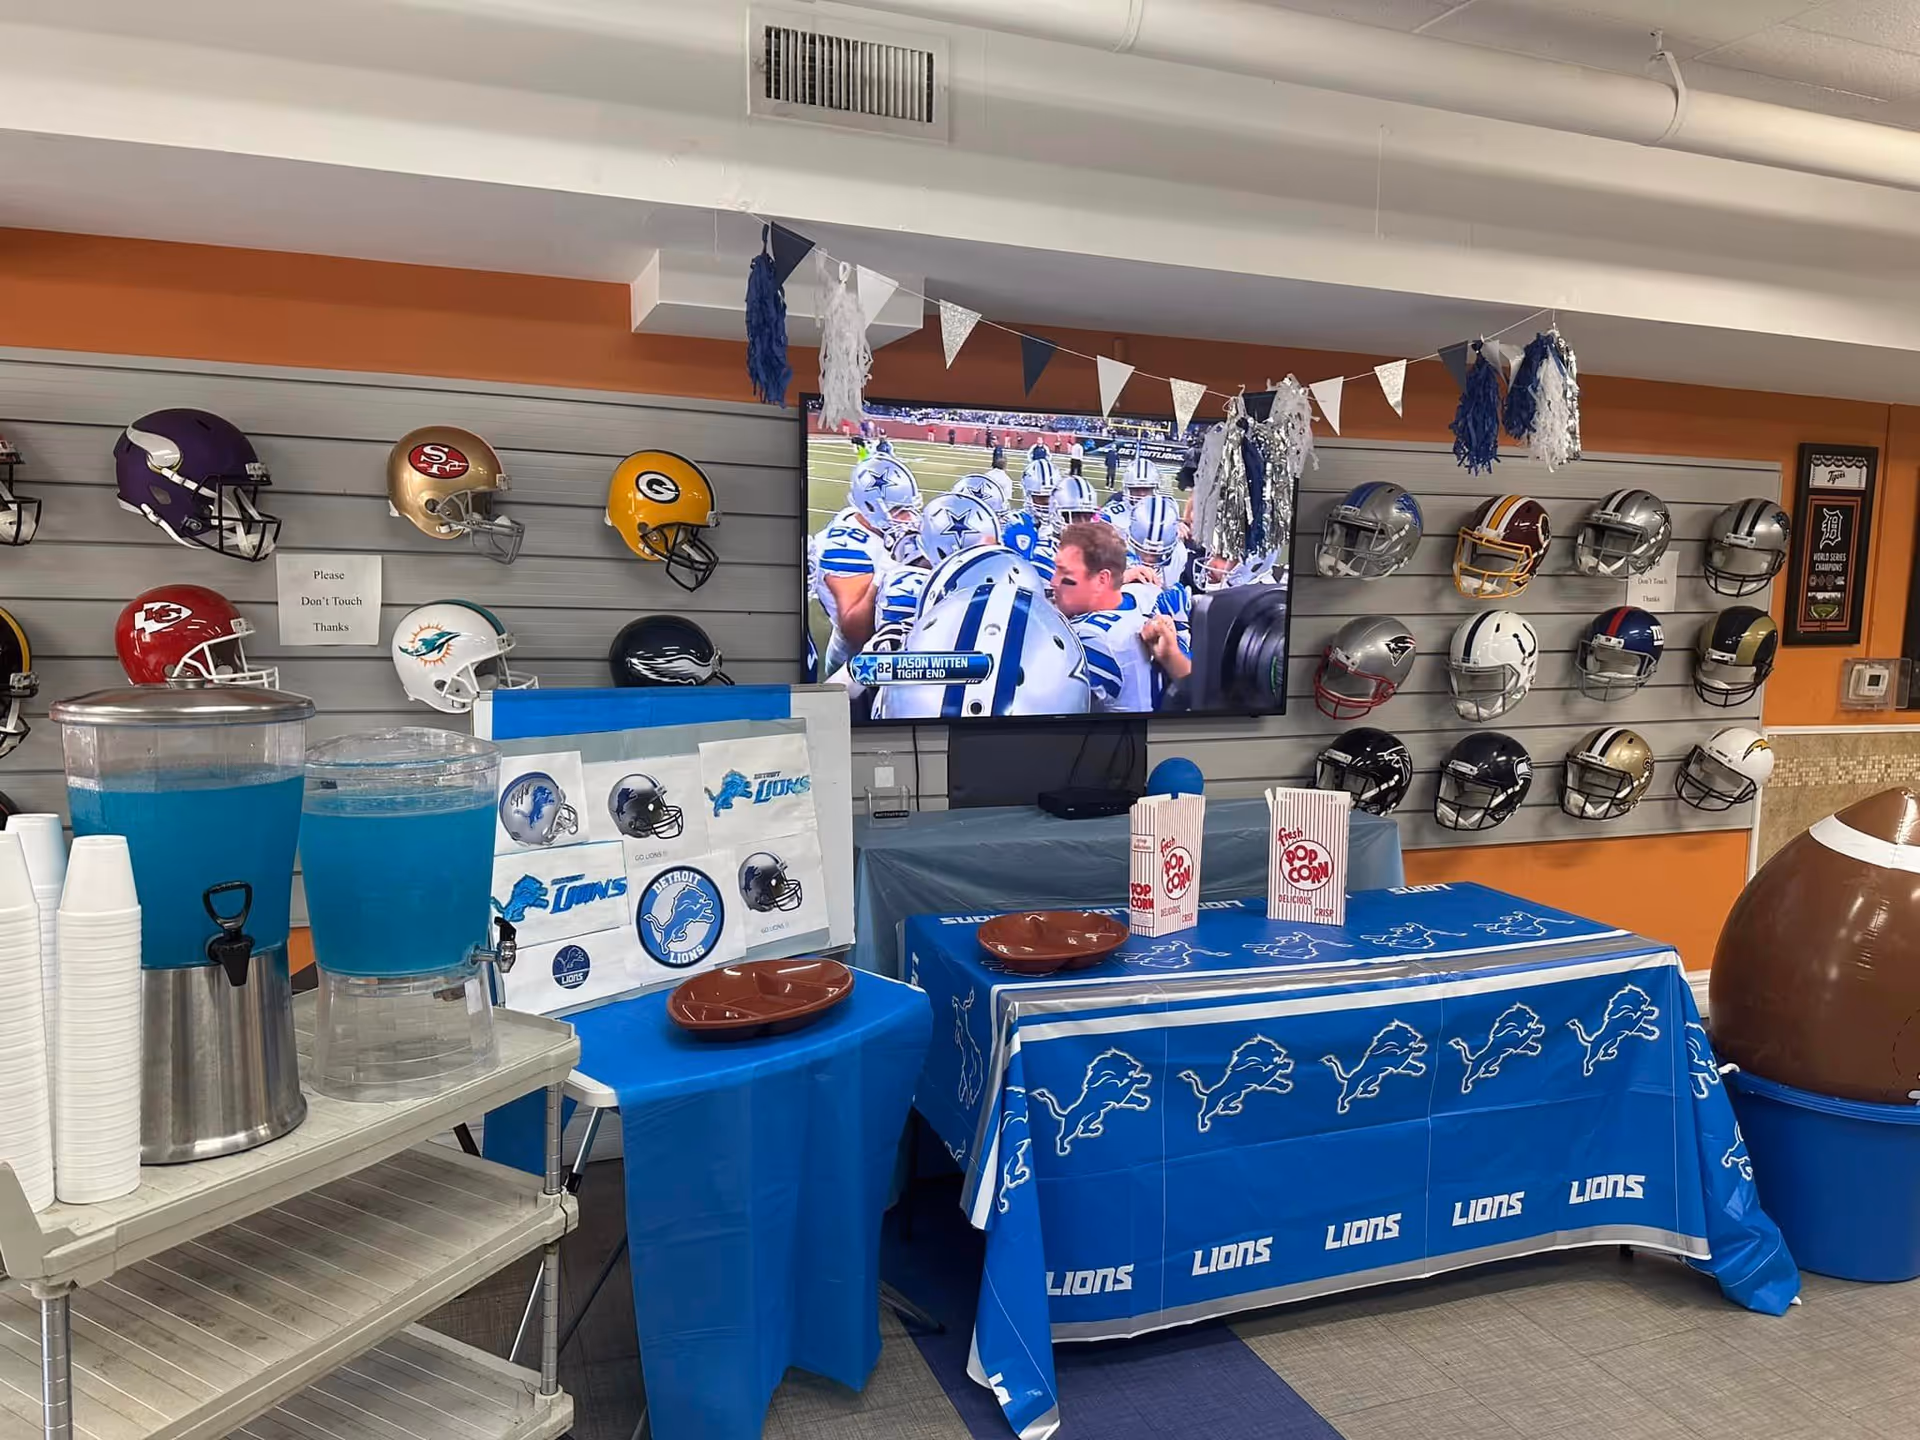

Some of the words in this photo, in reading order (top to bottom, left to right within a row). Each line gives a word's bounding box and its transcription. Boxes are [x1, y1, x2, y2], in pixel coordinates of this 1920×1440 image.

[1813, 552, 1830, 561] WORLD
[1830, 552, 1847, 562] SERIES
[1815, 562, 1843, 572] CHAMPIONS
[313, 570, 345, 580] Please
[301, 596, 329, 606] Don't
[332, 596, 363, 606] Touch
[313, 622, 349, 632] Thanks
[877, 662, 892, 673] 82
[896, 657, 925, 669] JASON
[930, 656, 968, 668] WITTEN
[896, 669, 922, 679] TIGHT
[926, 669, 946, 679] END
[752, 775, 811, 804] LIONS
[1278, 827, 1303, 847] fresh
[1160, 836, 1176, 858] fresh
[634, 854, 644, 862] GO
[645, 851, 662, 860] LIONS
[1285, 844, 1318, 867] POP
[1164, 853, 1184, 878] POP
[1288, 861, 1330, 884] CORN
[652, 870, 701, 894] DETROIT
[1166, 865, 1191, 894] CORN
[1131, 883, 1152, 897] POP
[1131, 896, 1154, 910] CORN
[1278, 894, 1313, 906] DELICIOUS
[1160, 905, 1181, 918] DELICIOUS
[1314, 907, 1335, 917] CRISP
[760, 926, 769, 934] GO
[770, 923, 785, 932] LIONS
[669, 944, 705, 964] LIONS
[561, 972, 584, 984] LIONS
[1569, 1174, 1646, 1205] LIONS
[1452, 1190, 1525, 1227] LIONS
[1325, 1213, 1402, 1250] LIONS
[1192, 1236, 1273, 1276] LIONS
[1045, 1263, 1135, 1296] LIONS
